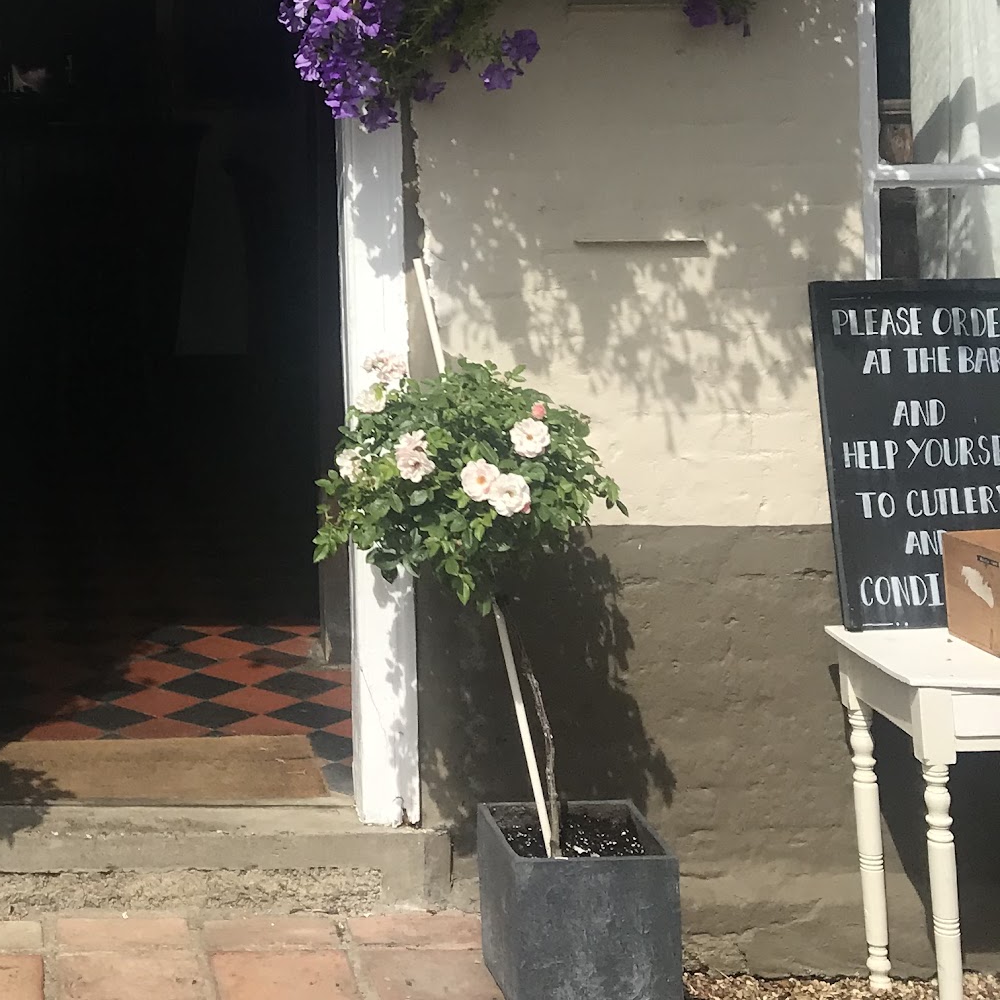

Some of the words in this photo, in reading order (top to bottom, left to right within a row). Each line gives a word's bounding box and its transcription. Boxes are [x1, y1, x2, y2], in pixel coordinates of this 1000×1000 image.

[832, 306, 922, 337] PLEASE
[863, 348, 892, 374] AT
[903, 346, 952, 373] THE
[958, 345, 1000, 373] BAR
[893, 399, 946, 426] AND
[842, 438, 899, 470] HELP
[855, 492, 896, 519] TO
